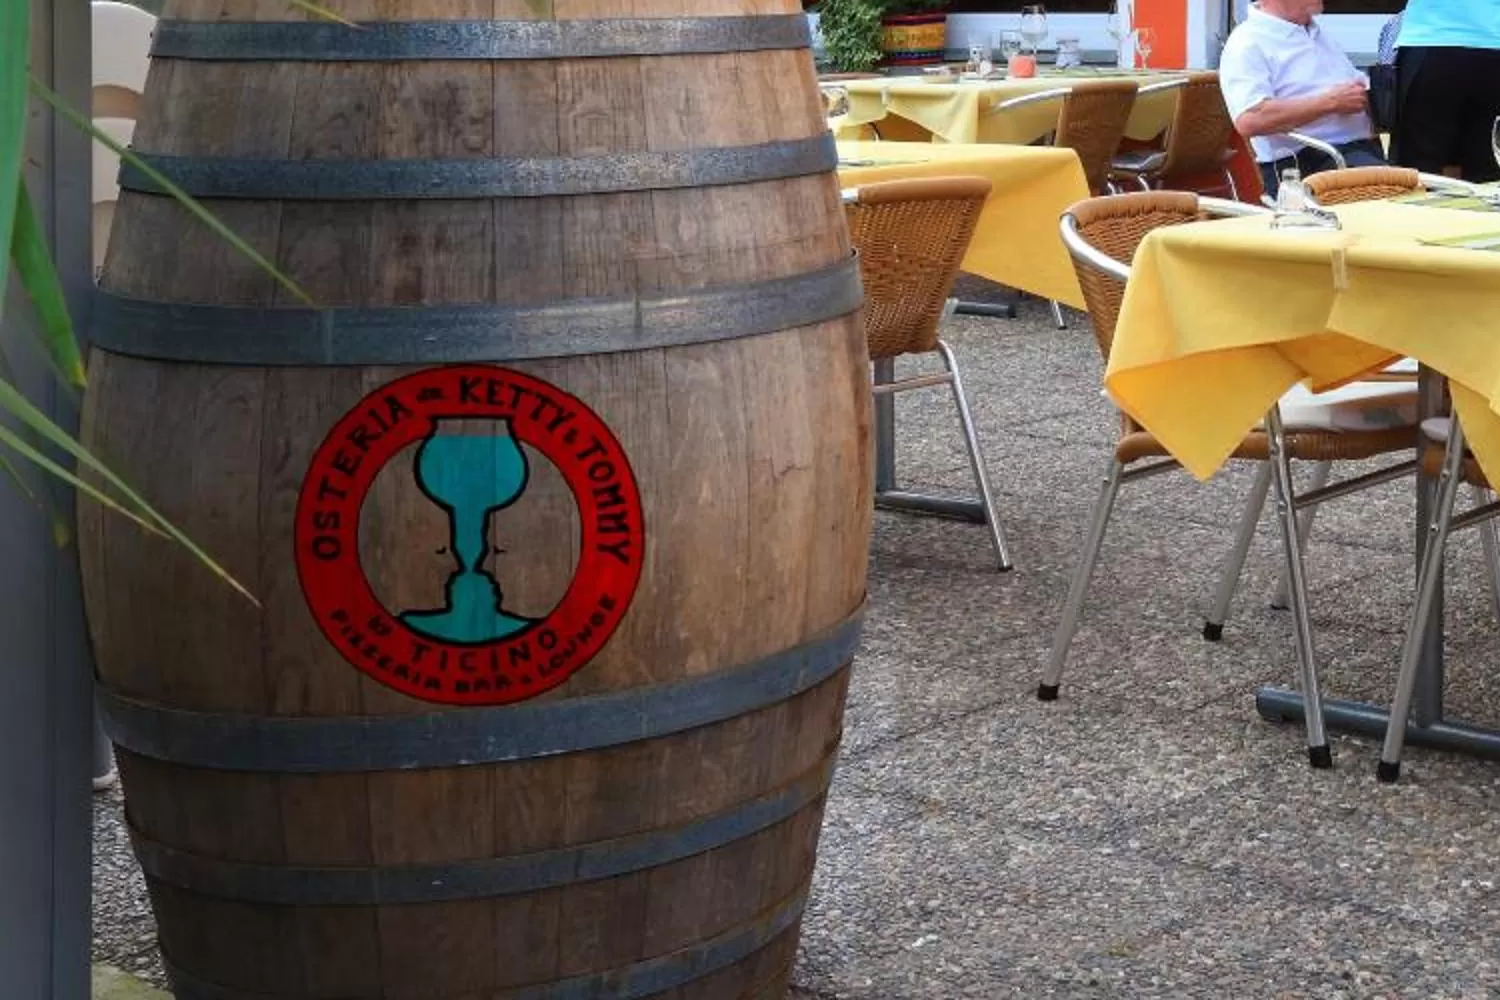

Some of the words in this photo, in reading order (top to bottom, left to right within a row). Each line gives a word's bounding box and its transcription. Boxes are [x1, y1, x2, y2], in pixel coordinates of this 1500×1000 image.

[311, 394, 414, 561] OSTERIA
[459, 375, 577, 433] KETTY
[576, 434, 631, 566] TOMMY
[411, 629, 558, 673] TICINO
